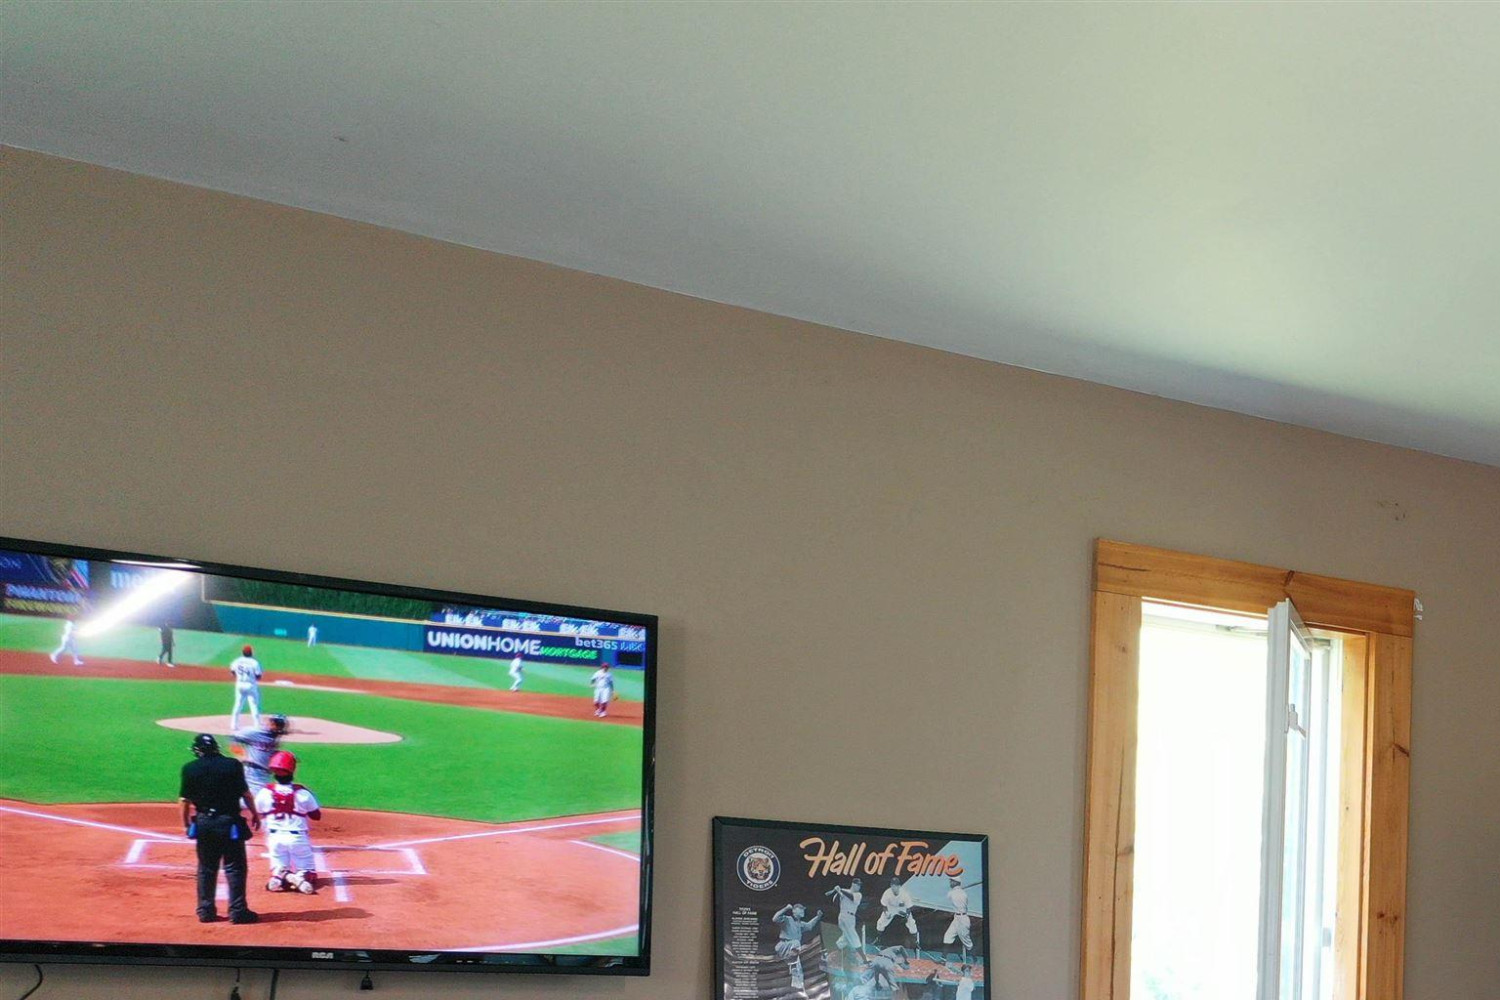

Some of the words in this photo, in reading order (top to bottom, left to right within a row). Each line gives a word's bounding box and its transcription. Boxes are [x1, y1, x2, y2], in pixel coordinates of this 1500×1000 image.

[575, 636, 617, 650] bet365
[800, 837, 867, 878] Hall
[864, 843, 898, 875] of
[895, 841, 964, 876] Fame
[746, 879, 773, 889] TIGERS
